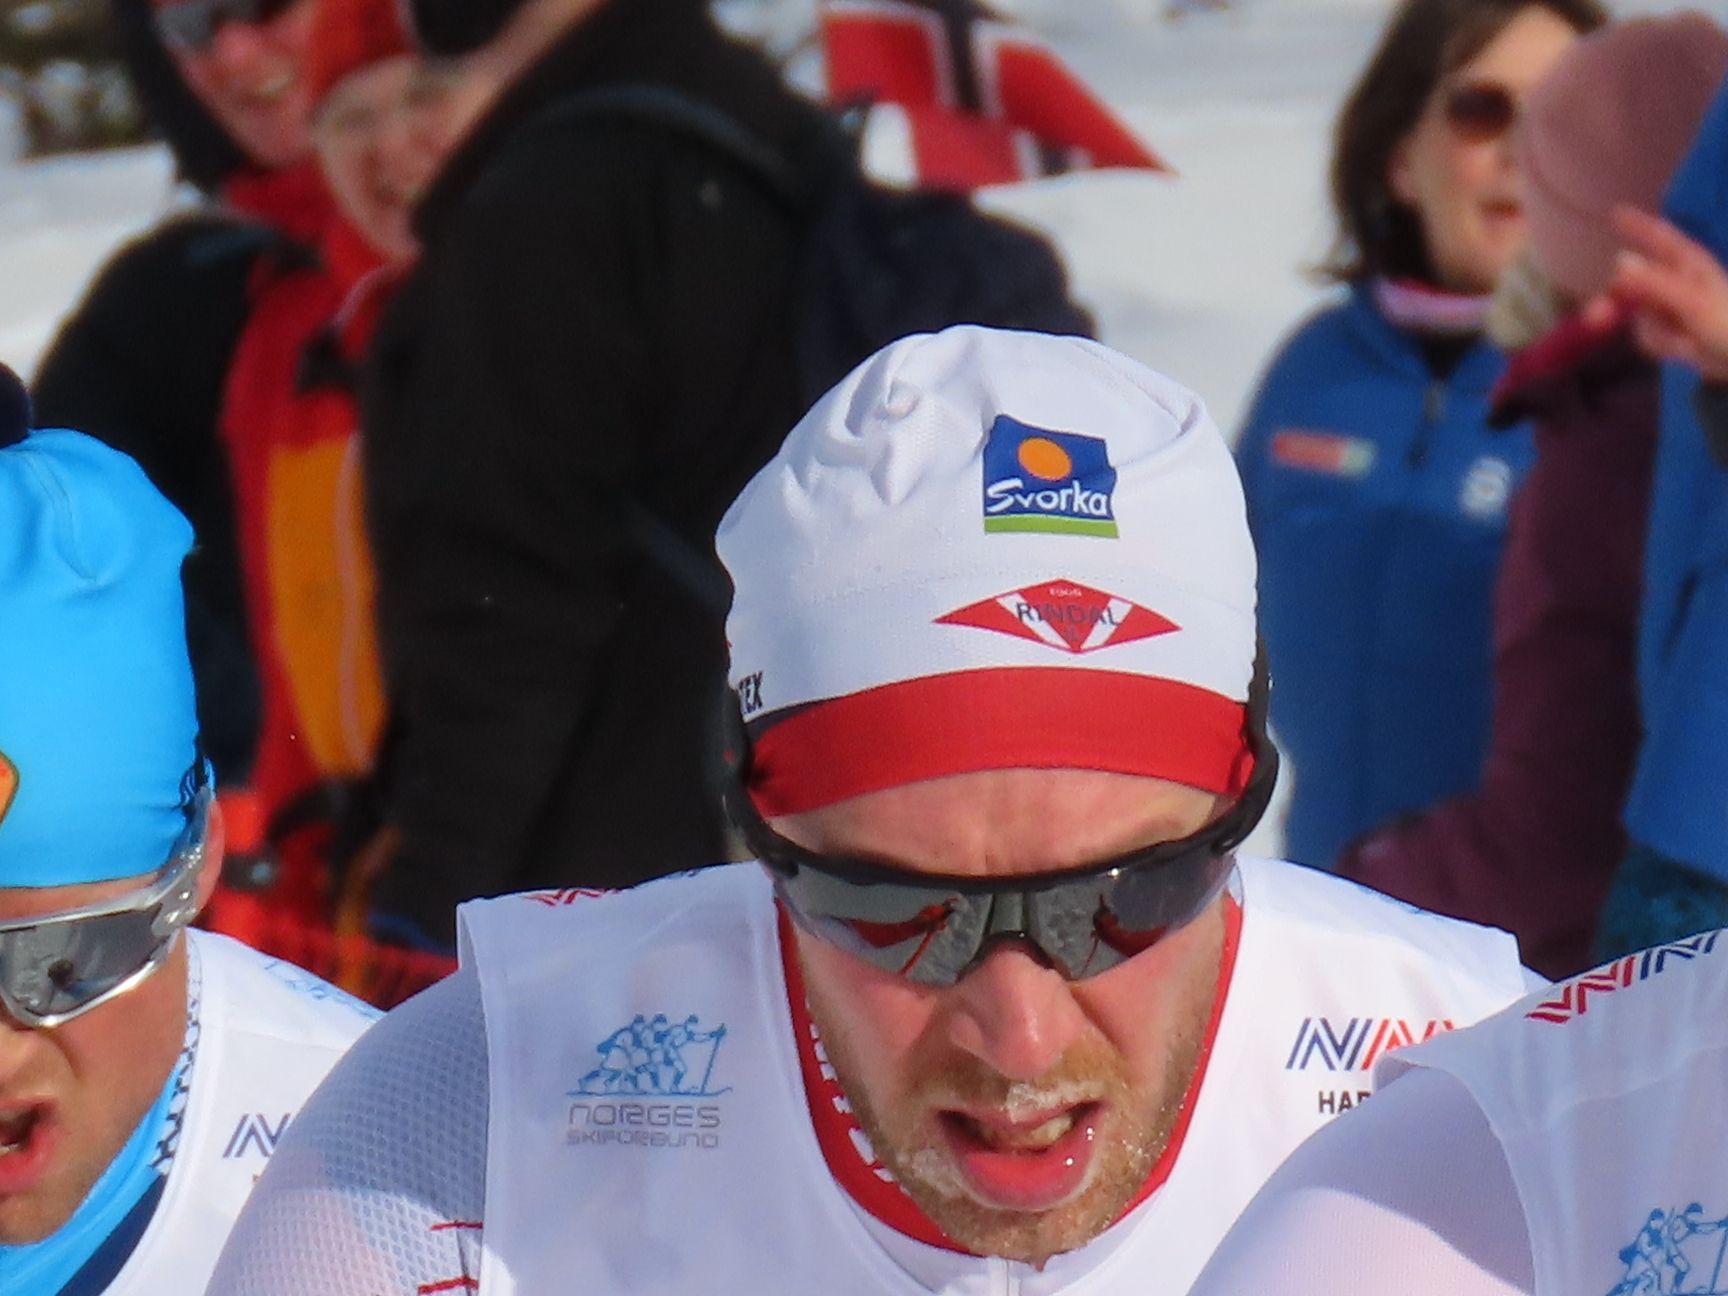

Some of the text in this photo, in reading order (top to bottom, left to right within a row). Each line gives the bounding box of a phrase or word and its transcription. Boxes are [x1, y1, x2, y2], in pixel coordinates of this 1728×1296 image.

[986, 479, 1108, 515] Svorka
[1016, 602, 1120, 626] RINDAL
[570, 1104, 720, 1128] NORGES
